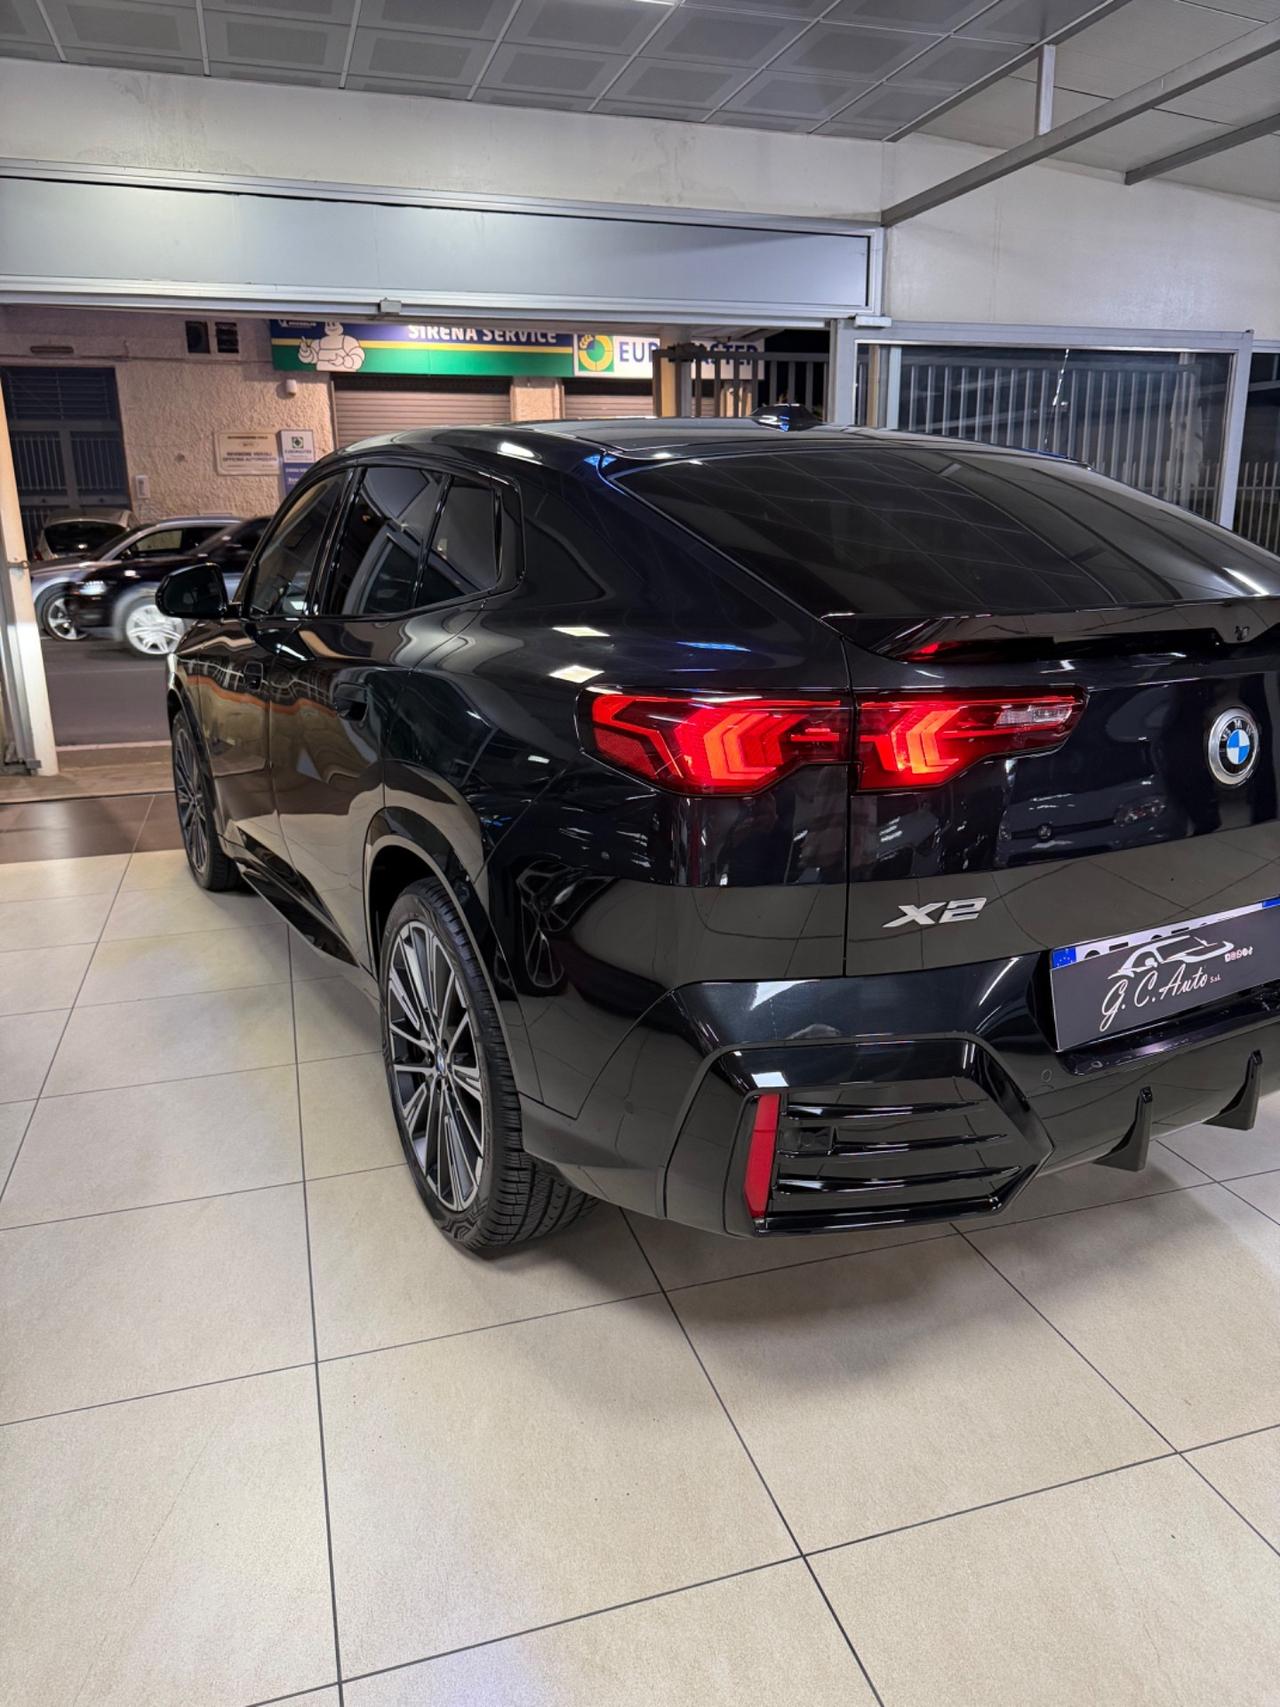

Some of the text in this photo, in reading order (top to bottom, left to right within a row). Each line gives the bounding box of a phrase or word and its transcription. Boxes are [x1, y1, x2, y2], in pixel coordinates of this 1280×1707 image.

[408, 325, 557, 343] SIRENA SERVICE
[882, 897, 987, 928] X2
[1159, 963, 1208, 1000] Auto
